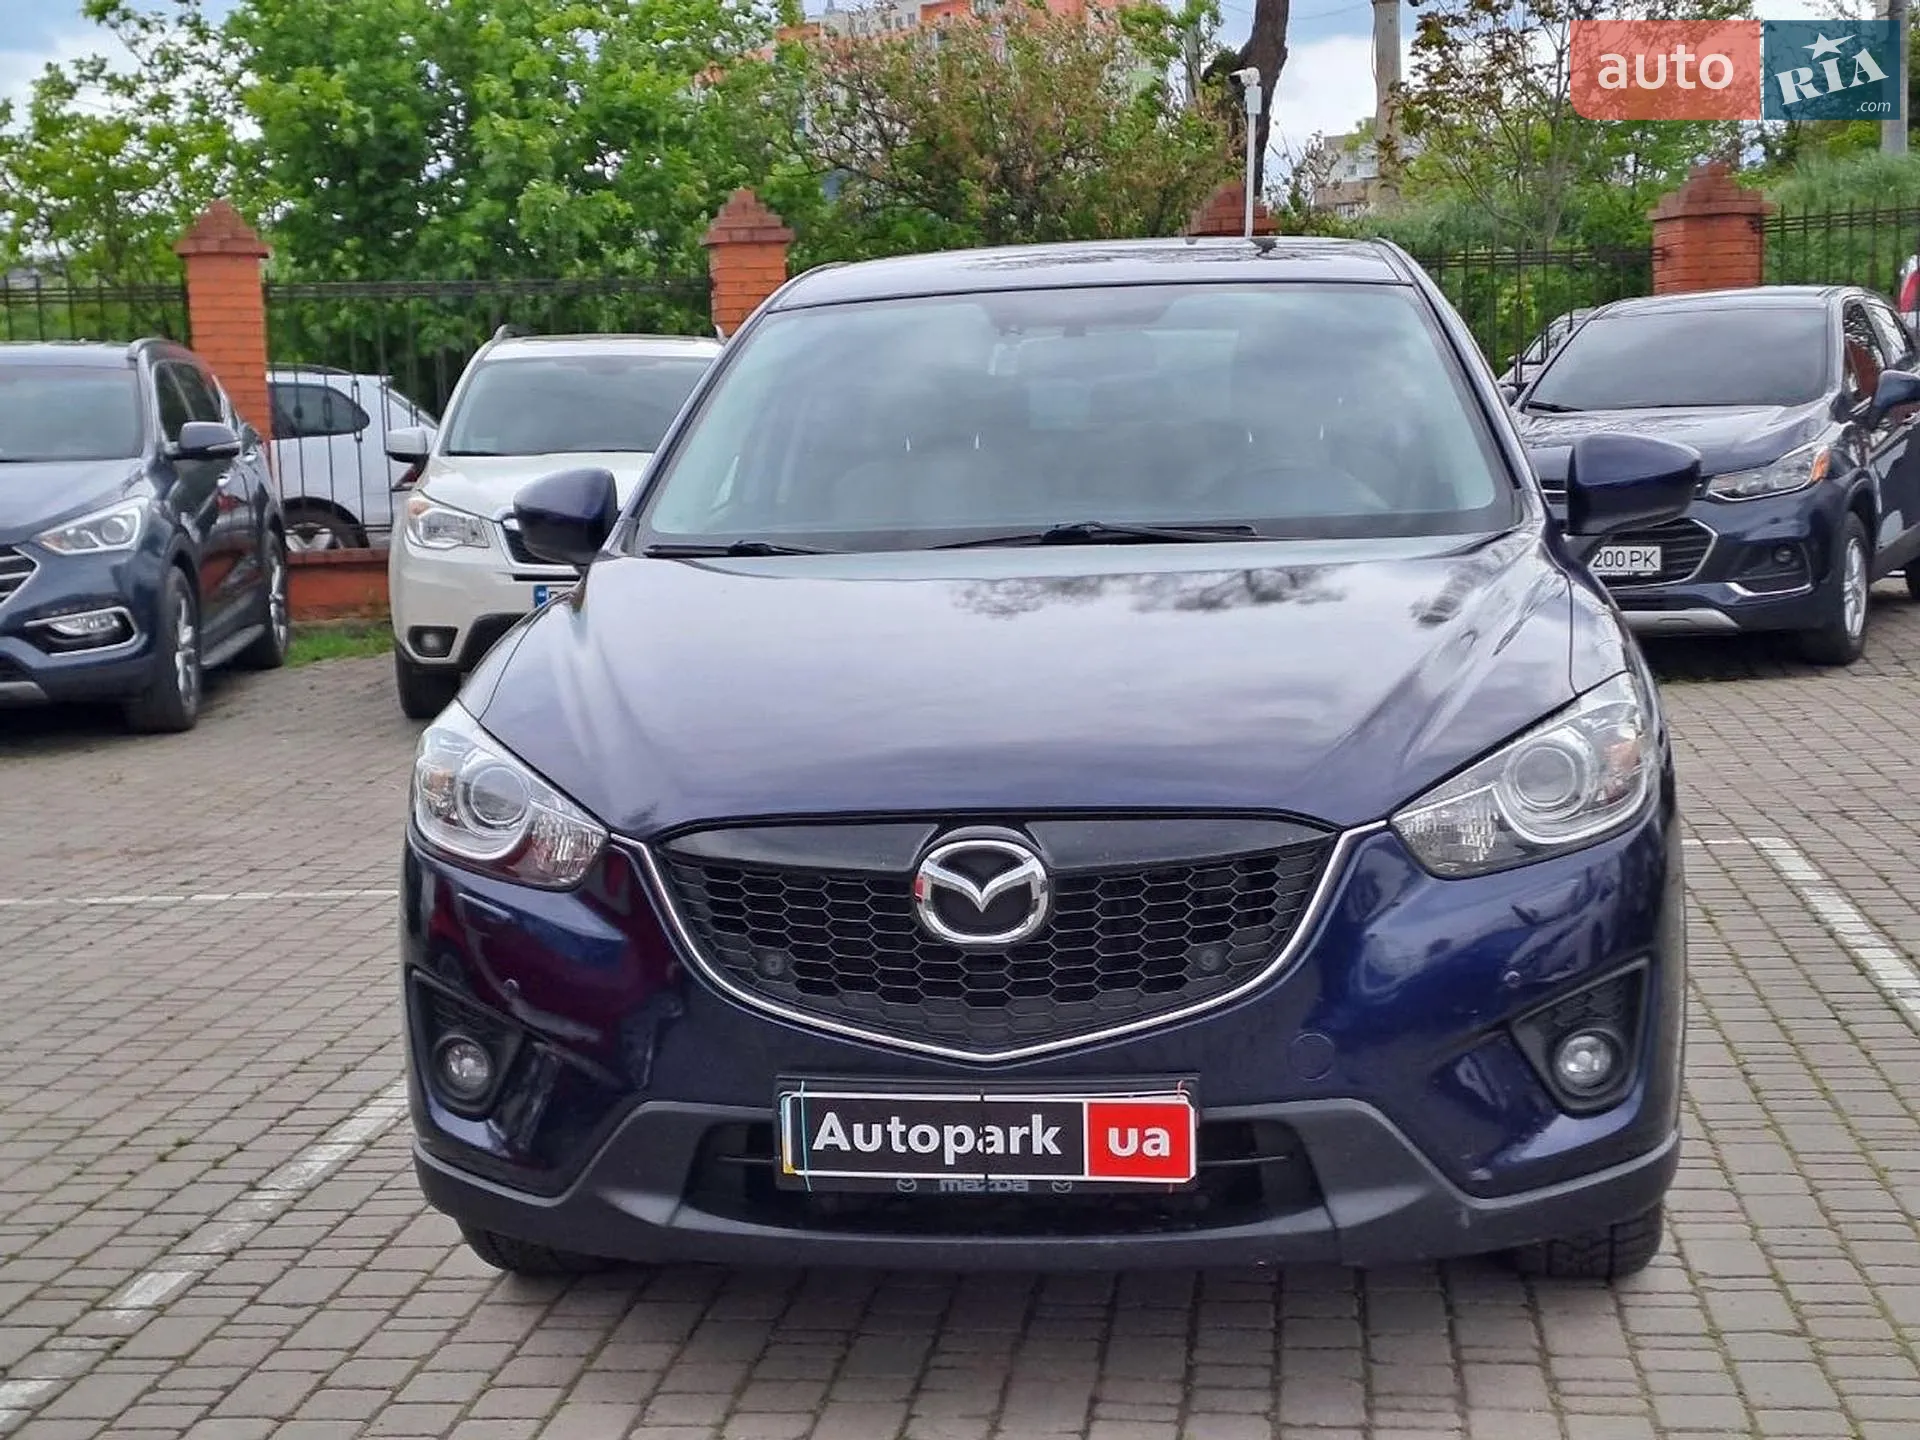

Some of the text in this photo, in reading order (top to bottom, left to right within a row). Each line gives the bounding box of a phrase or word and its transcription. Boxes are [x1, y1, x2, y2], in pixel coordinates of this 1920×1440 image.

[1630, 551, 1656, 567] PK
[812, 1112, 1170, 1165] Autopark ua
